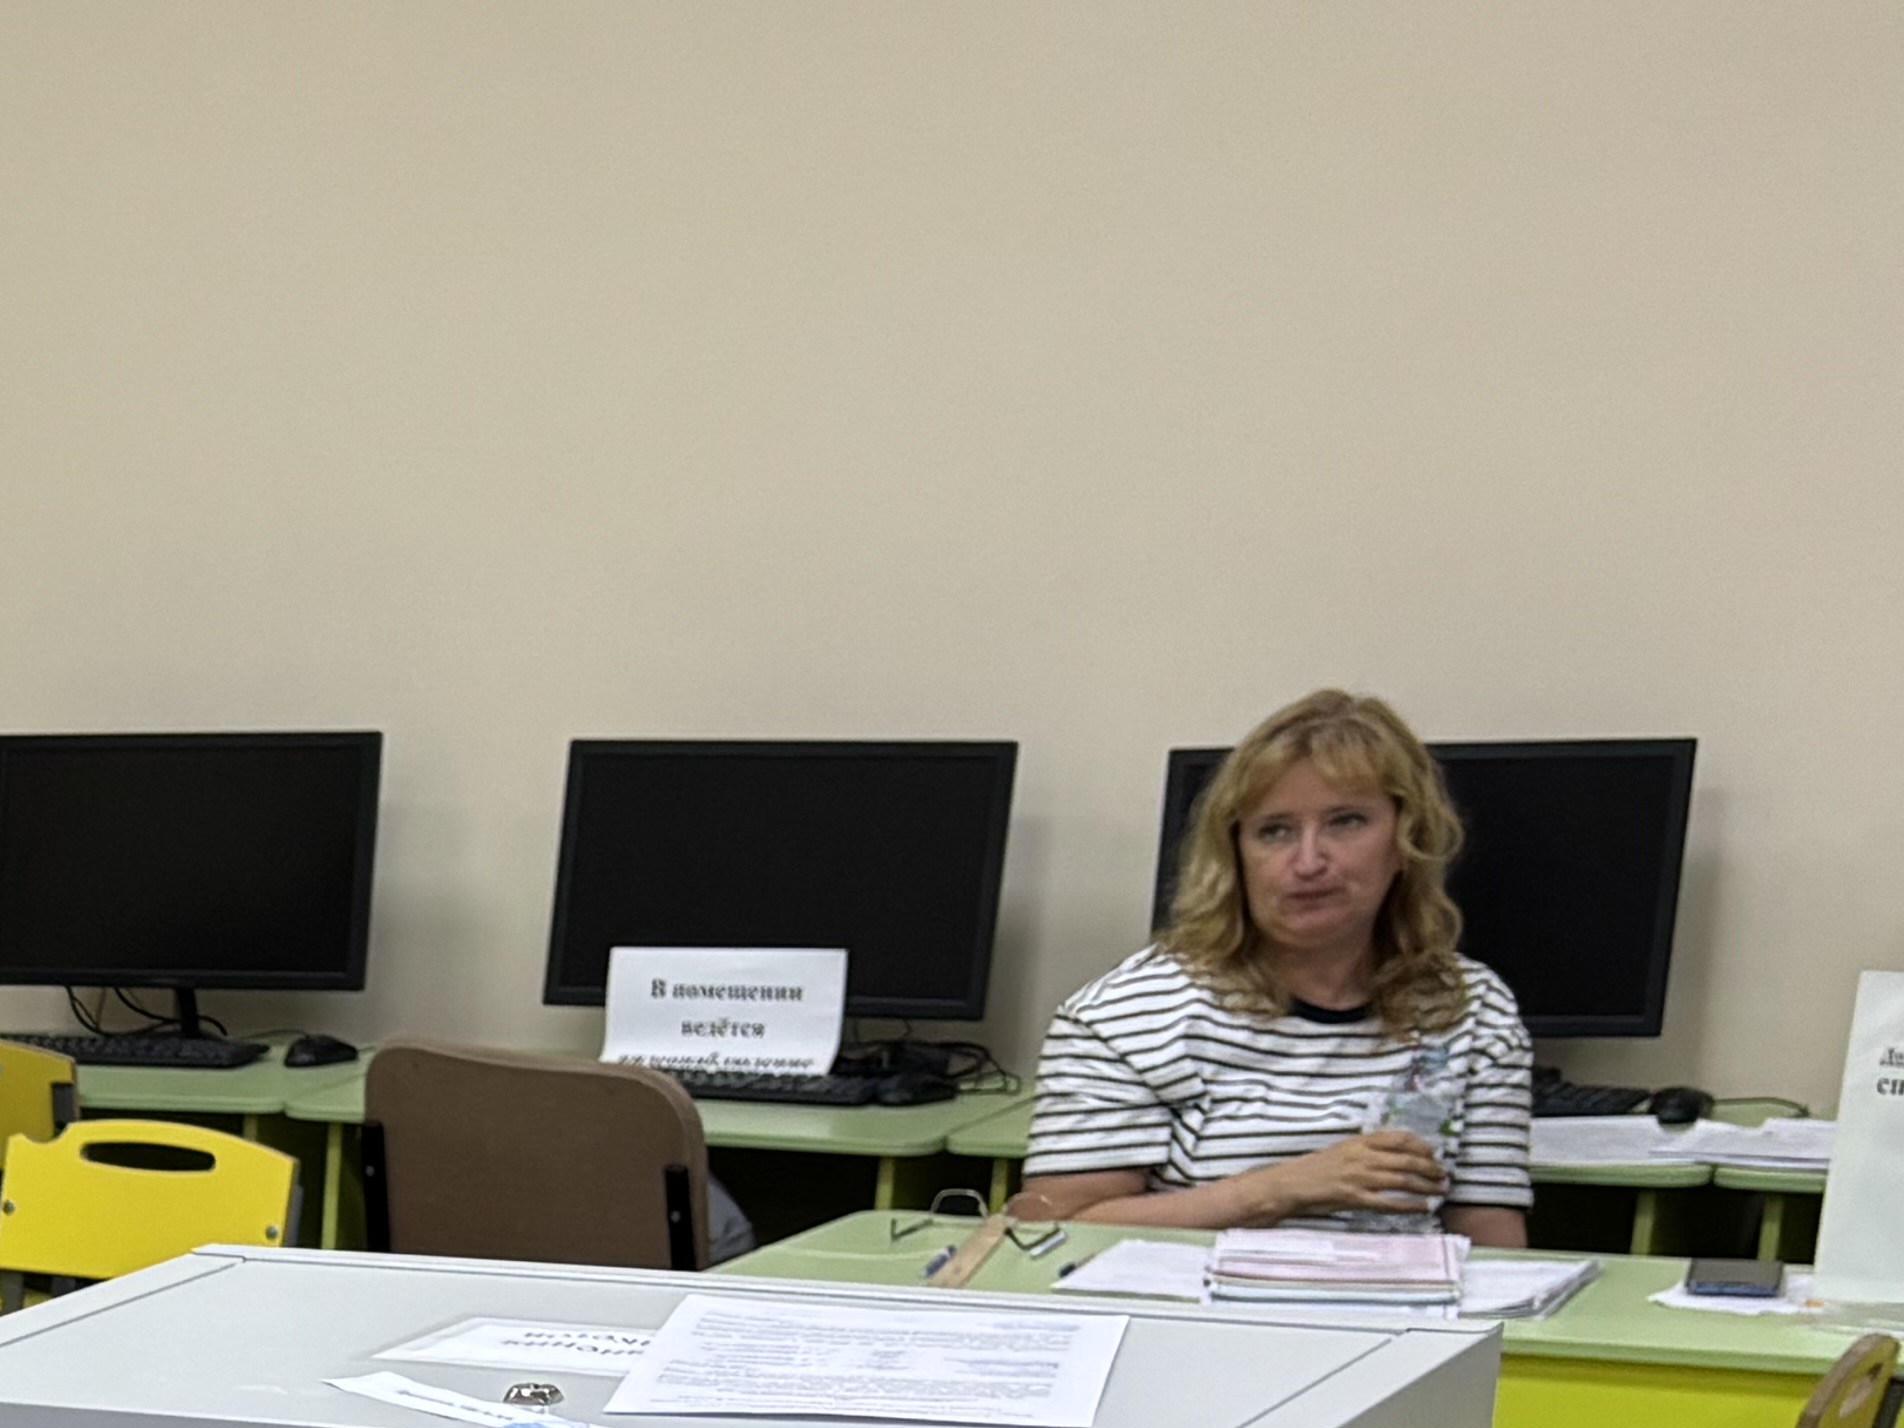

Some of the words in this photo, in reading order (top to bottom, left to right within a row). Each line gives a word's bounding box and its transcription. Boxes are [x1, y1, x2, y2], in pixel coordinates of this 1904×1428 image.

[650, 977, 668, 999] В
[671, 983, 805, 1002] помещении
[680, 1017, 767, 1039] ведётся
